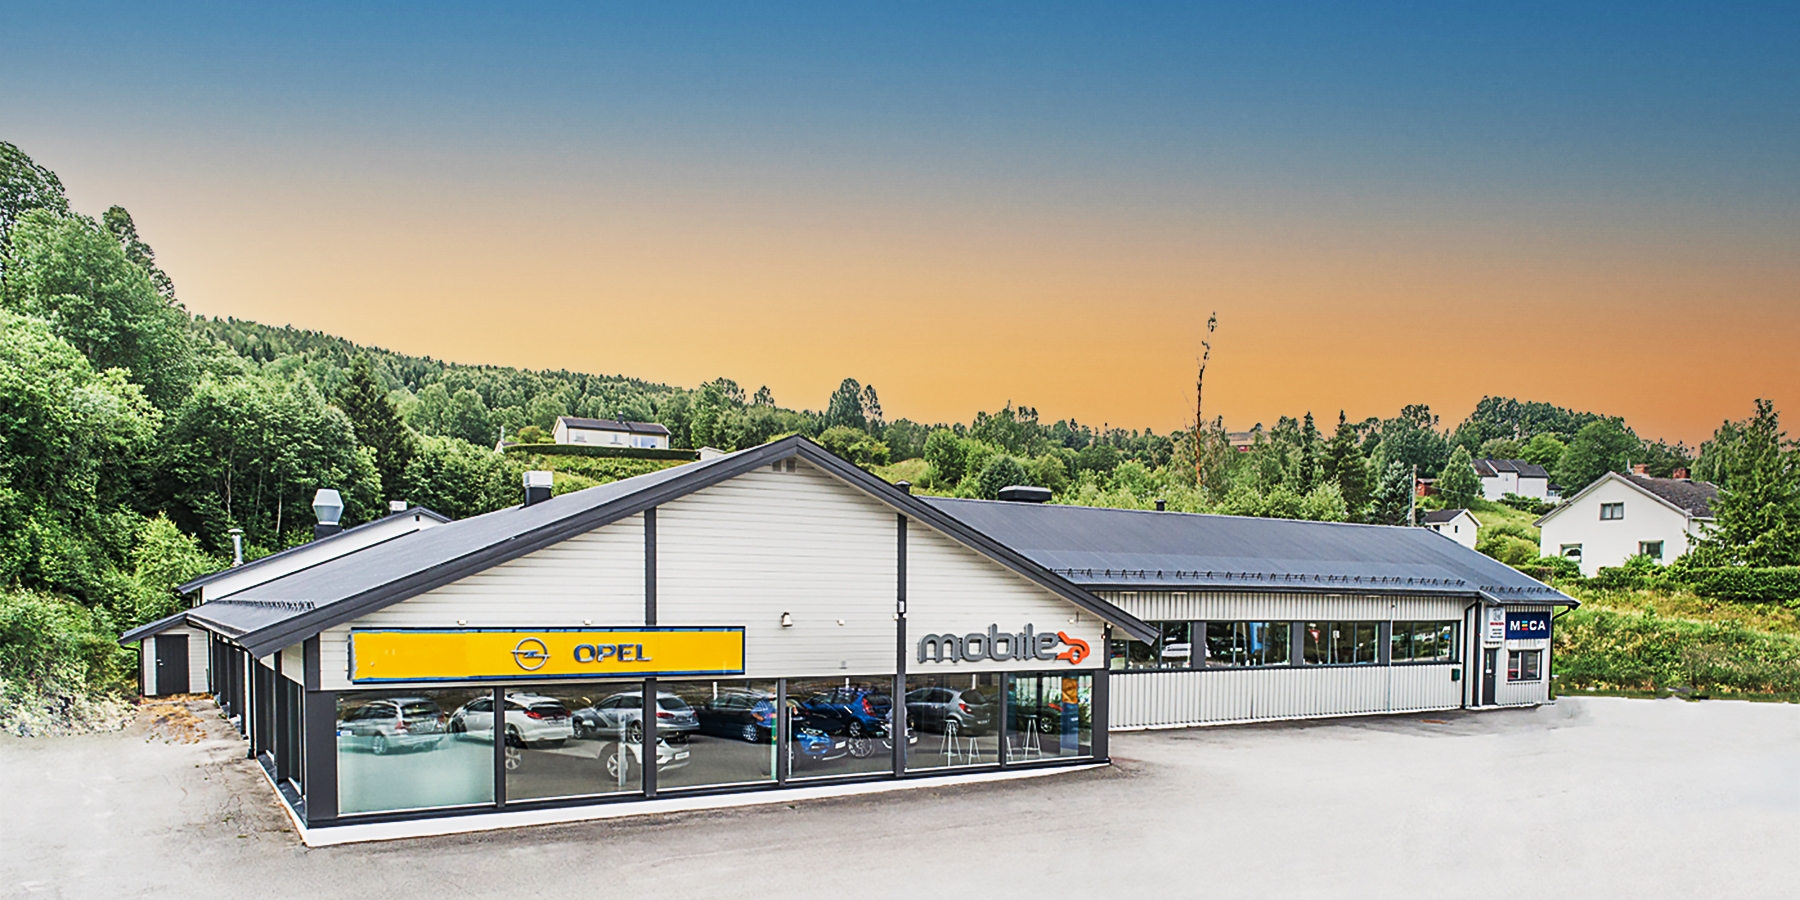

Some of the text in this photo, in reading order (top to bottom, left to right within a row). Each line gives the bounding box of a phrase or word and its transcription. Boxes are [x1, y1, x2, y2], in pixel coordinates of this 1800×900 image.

[1510, 620, 1546, 631] MECA
[573, 643, 652, 662] OPEL
[917, 623, 1059, 664] mobile
